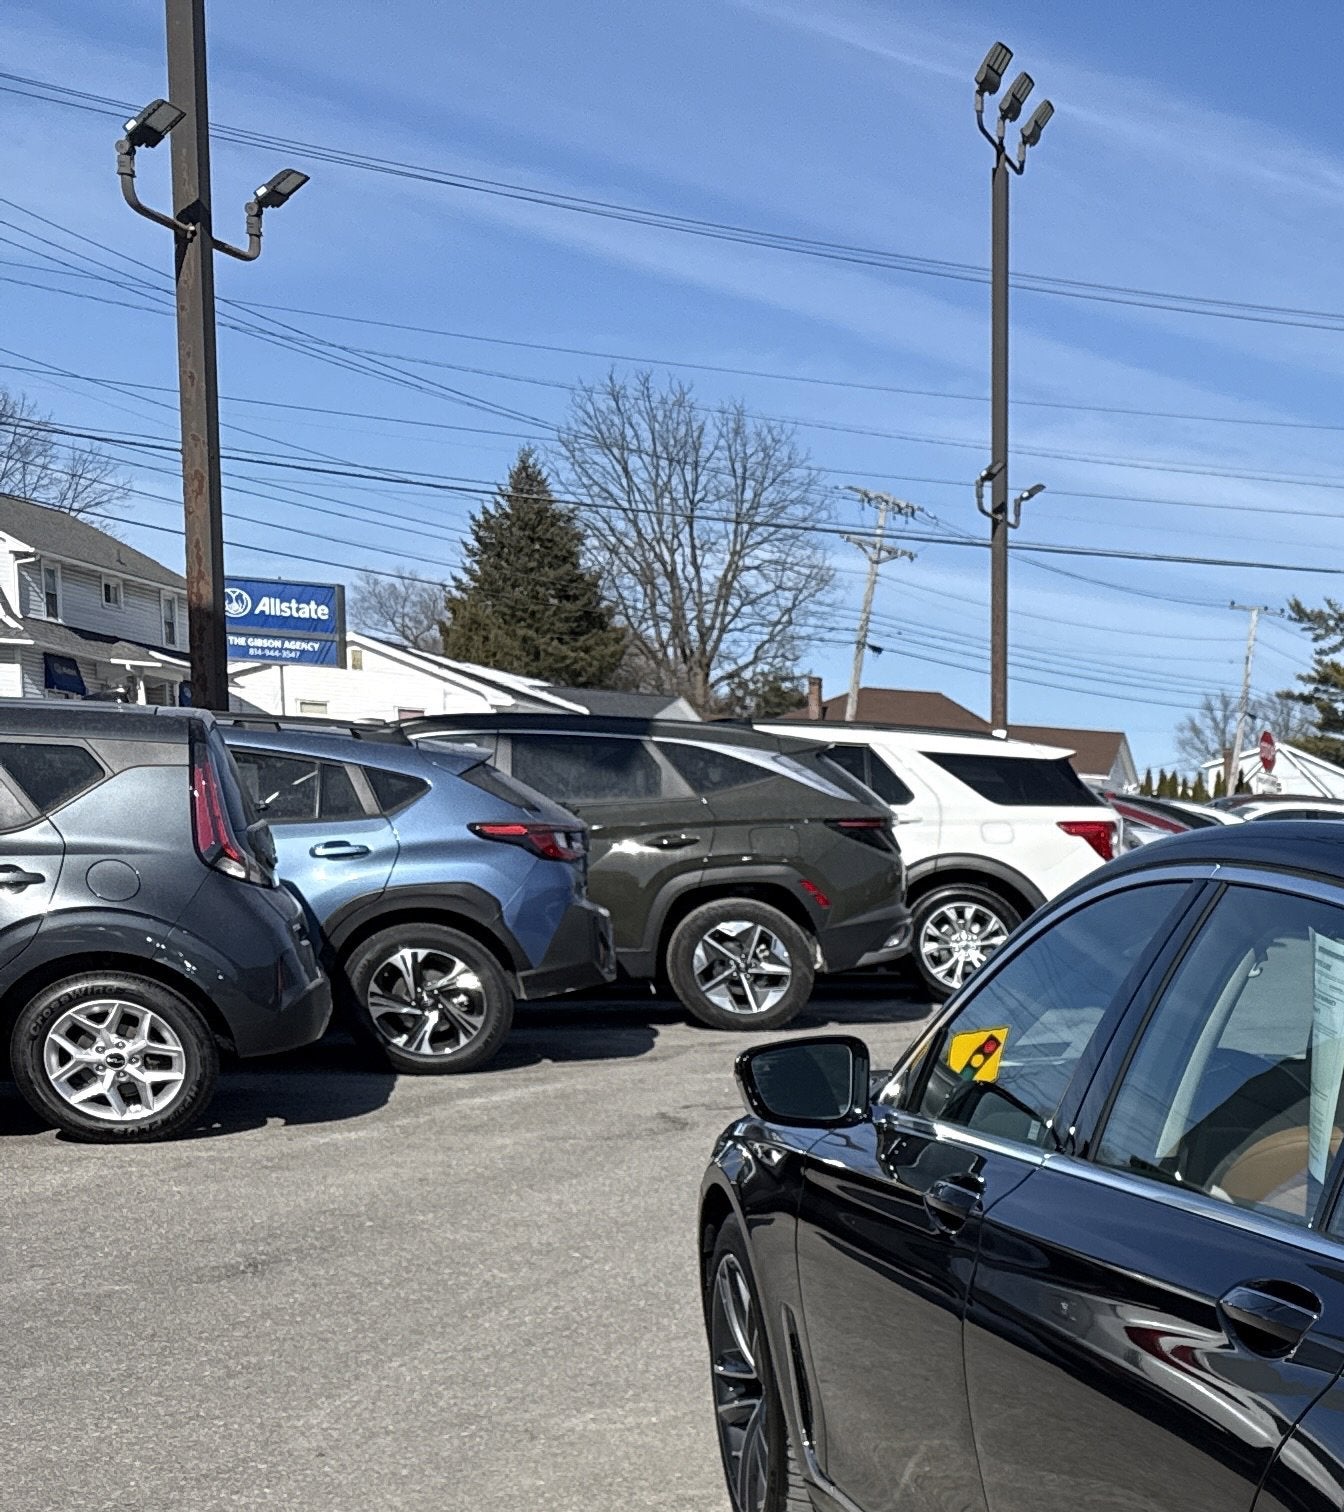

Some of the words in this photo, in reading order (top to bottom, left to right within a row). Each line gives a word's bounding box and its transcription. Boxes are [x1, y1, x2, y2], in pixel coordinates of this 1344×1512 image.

[254, 597, 329, 619] Allstate
[228, 636, 246, 647] THE
[247, 638, 282, 649] GIBSON
[283, 641, 320, 651] AGENCY
